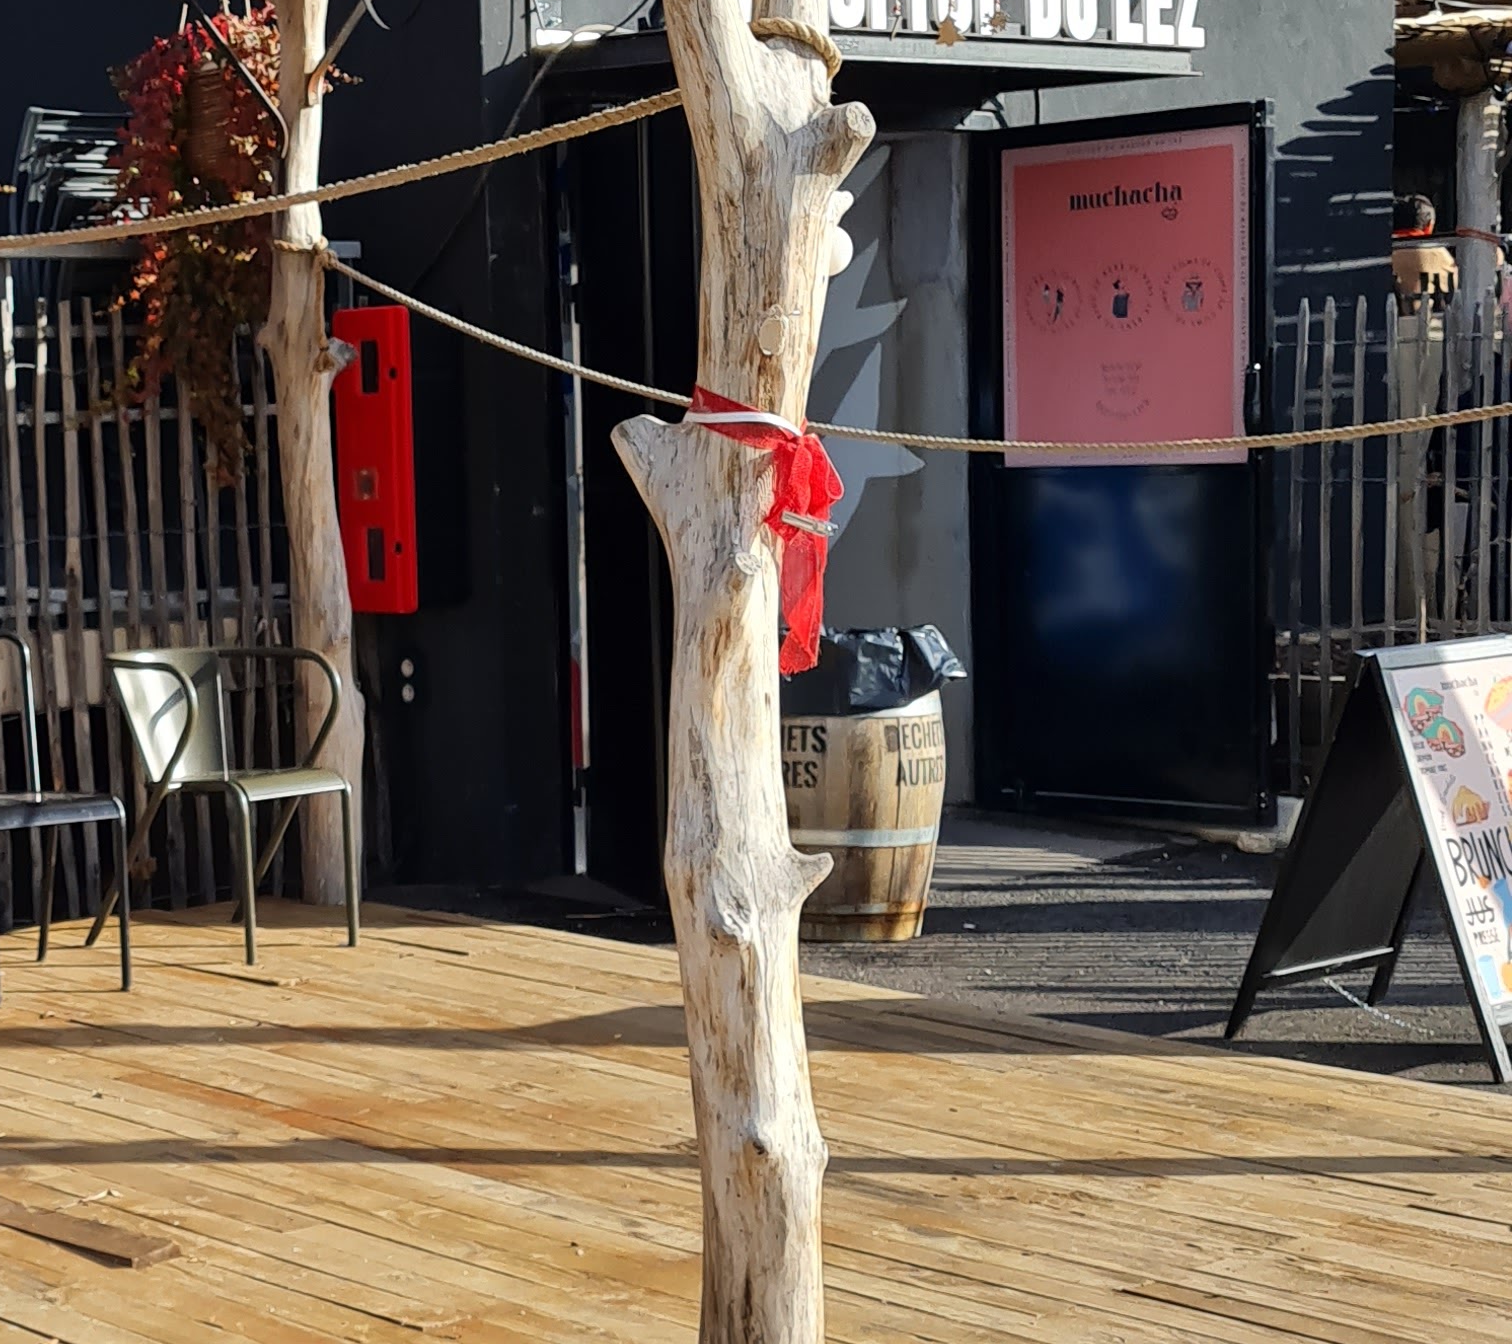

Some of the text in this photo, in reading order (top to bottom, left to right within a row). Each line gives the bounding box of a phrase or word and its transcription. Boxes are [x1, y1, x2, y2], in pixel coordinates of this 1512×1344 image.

[1068, 181, 1184, 213] muchacha
[780, 723, 828, 754] ETS
[1465, 894, 1495, 927] JUS
